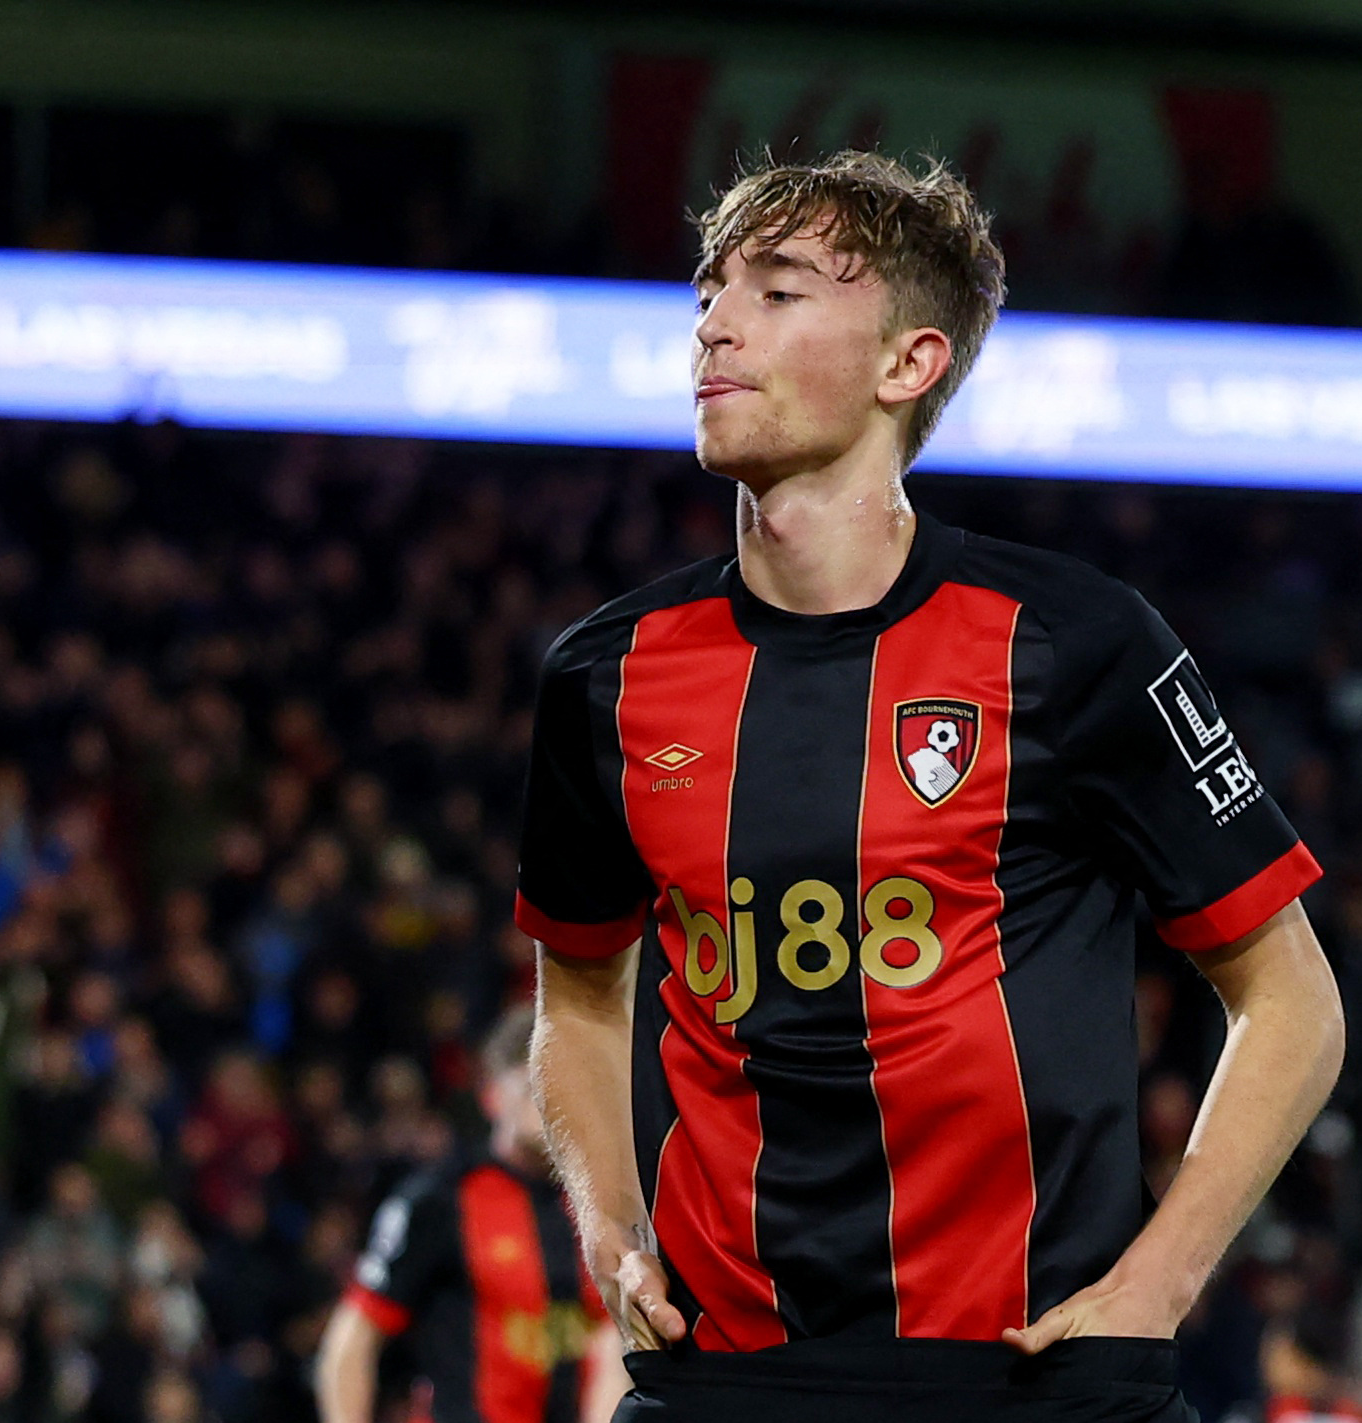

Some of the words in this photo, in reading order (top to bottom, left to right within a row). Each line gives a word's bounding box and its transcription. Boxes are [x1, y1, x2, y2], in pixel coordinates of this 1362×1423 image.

[902, 706, 917, 716] AFC
[918, 705, 973, 719] BOURNEMOUTH
[651, 776, 694, 792] umbro
[668, 876, 942, 1024] bj88
